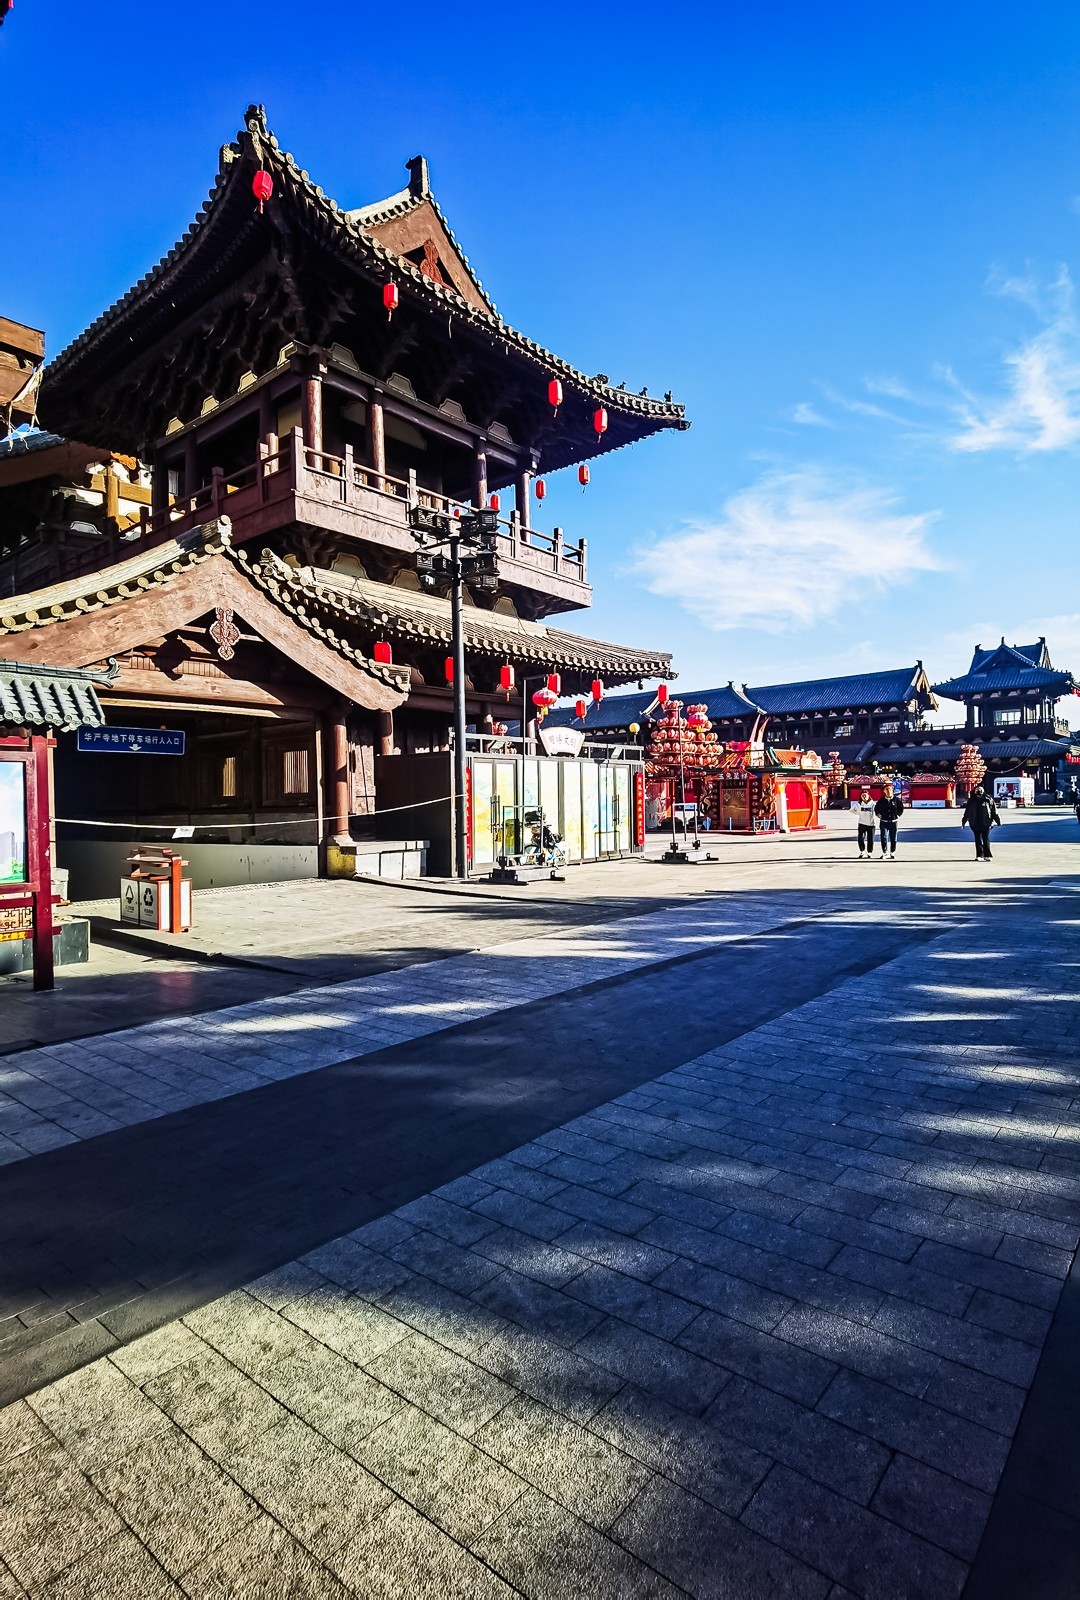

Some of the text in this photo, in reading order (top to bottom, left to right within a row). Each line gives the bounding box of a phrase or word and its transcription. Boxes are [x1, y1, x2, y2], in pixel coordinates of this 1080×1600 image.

[84, 732, 180, 745] 华严寺地下停车场行人入口
